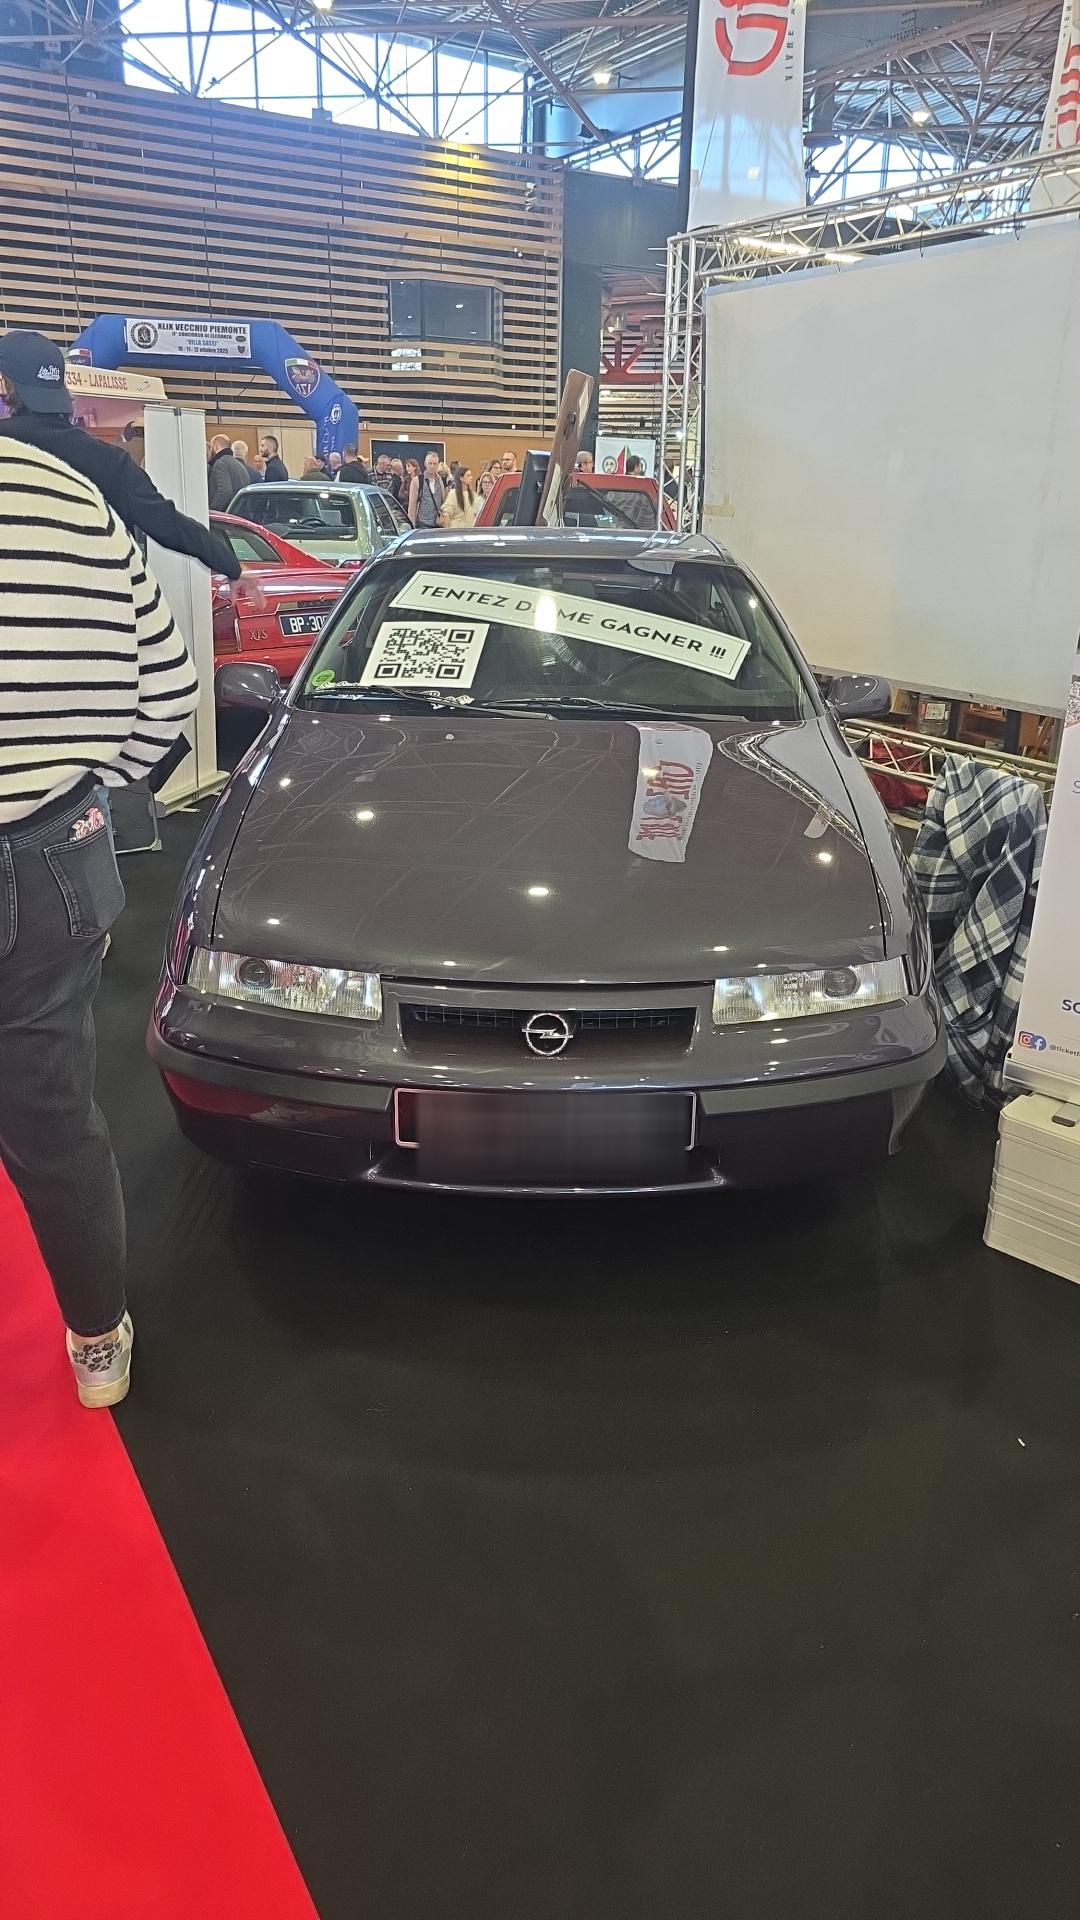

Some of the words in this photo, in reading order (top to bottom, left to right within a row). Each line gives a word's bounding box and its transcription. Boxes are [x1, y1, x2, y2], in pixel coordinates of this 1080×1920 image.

[784, 30, 794, 81] VIVRE
[175, 324, 208, 332] VECCHIO
[210, 326, 247, 334] PIEMONTE
[89, 373, 128, 390] LAPALISSE
[420, 585, 510, 608] TENTEZ
[557, 608, 594, 625] ME
[600, 618, 703, 652] GAGNER
[709, 645, 727, 660] !!!
[249, 629, 269, 640] XJS
[1050, 1045, 1080, 1056] @ticketf
